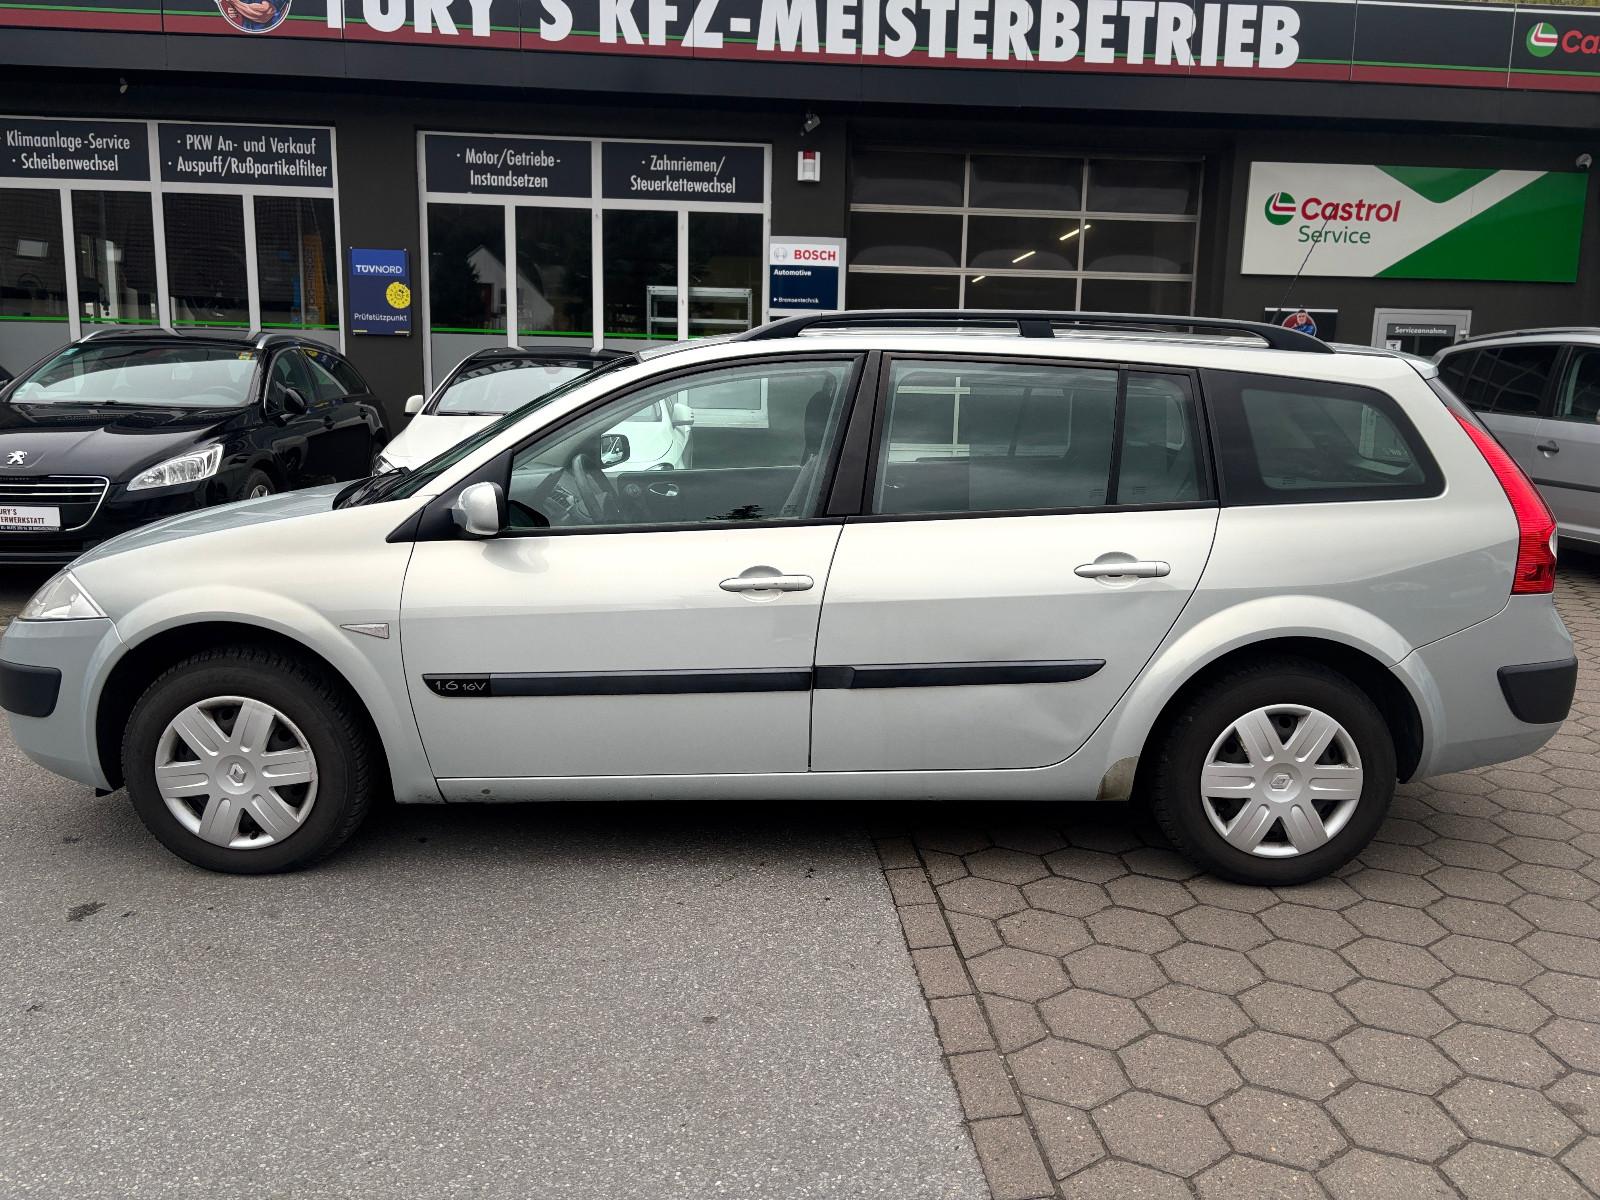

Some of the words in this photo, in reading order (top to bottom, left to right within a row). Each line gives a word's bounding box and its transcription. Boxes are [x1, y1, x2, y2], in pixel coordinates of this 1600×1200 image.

[599, 0, 1300, 69] KFZ-MEISTERBETRIEB
[1561, 30, 1600, 54] Ca
[186, 134, 213, 151] PKW
[217, 135, 238, 152] An-
[243, 136, 266, 153] und
[270, 136, 317, 155] Verkauf
[20, 152, 119, 172] Scheibenwechsel
[176, 156, 328, 178] Auspuff/Rußpartikelfilter
[465, 148, 561, 168] Motor/Getriebe-
[650, 155, 726, 176] Zahnriemen/
[470, 170, 549, 188] Instandsetzen
[630, 175, 736, 194] Steuerkettewechsel
[1301, 197, 1401, 222] Castrol
[1298, 225, 1371, 244] Service
[794, 249, 836, 261] BOSCH
[773, 269, 812, 277] Automotive
[354, 312, 407, 322] Prüfstützpunkt
[1394, 326, 1448, 335] Serviceannahme
[435, 680, 459, 691] 1.6
